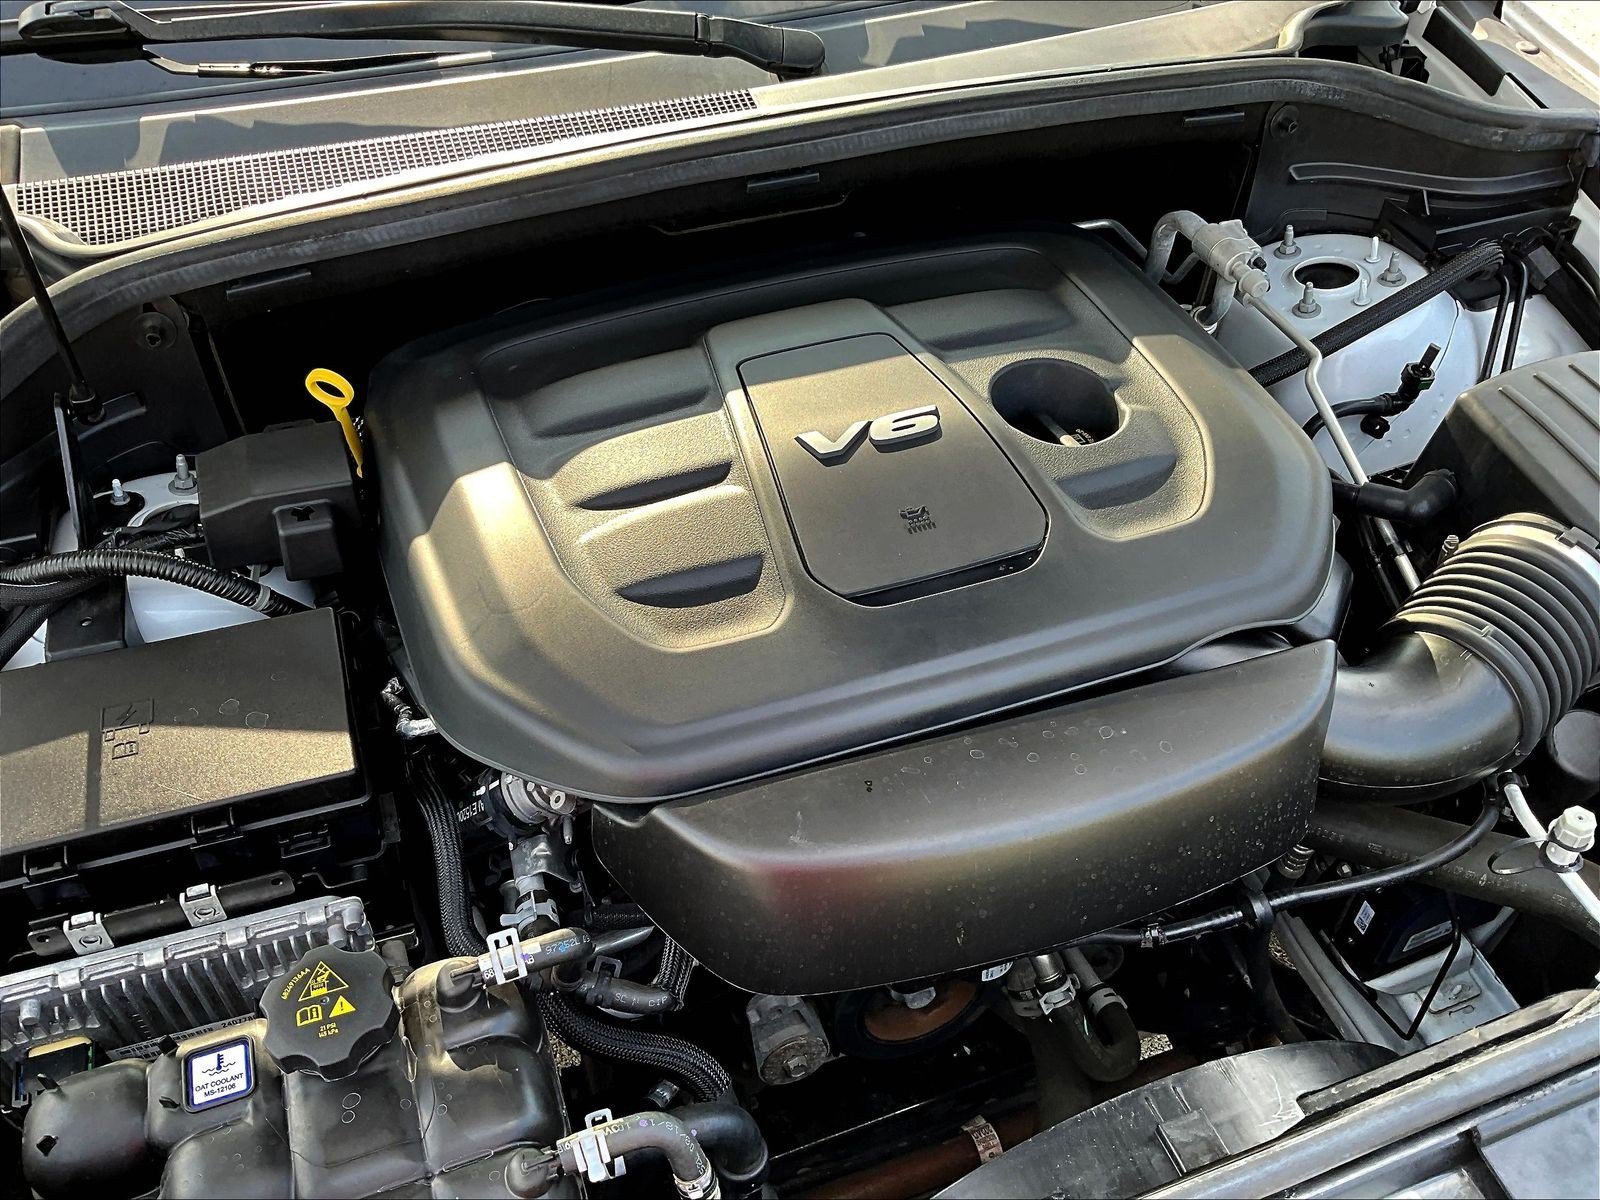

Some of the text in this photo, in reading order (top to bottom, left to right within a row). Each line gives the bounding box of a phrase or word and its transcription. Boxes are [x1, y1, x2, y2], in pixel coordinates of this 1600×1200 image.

[795, 404, 942, 467] V6
[195, 1072, 244, 1092] OAT COOLANT
[204, 1083, 237, 1097] MS-12106
